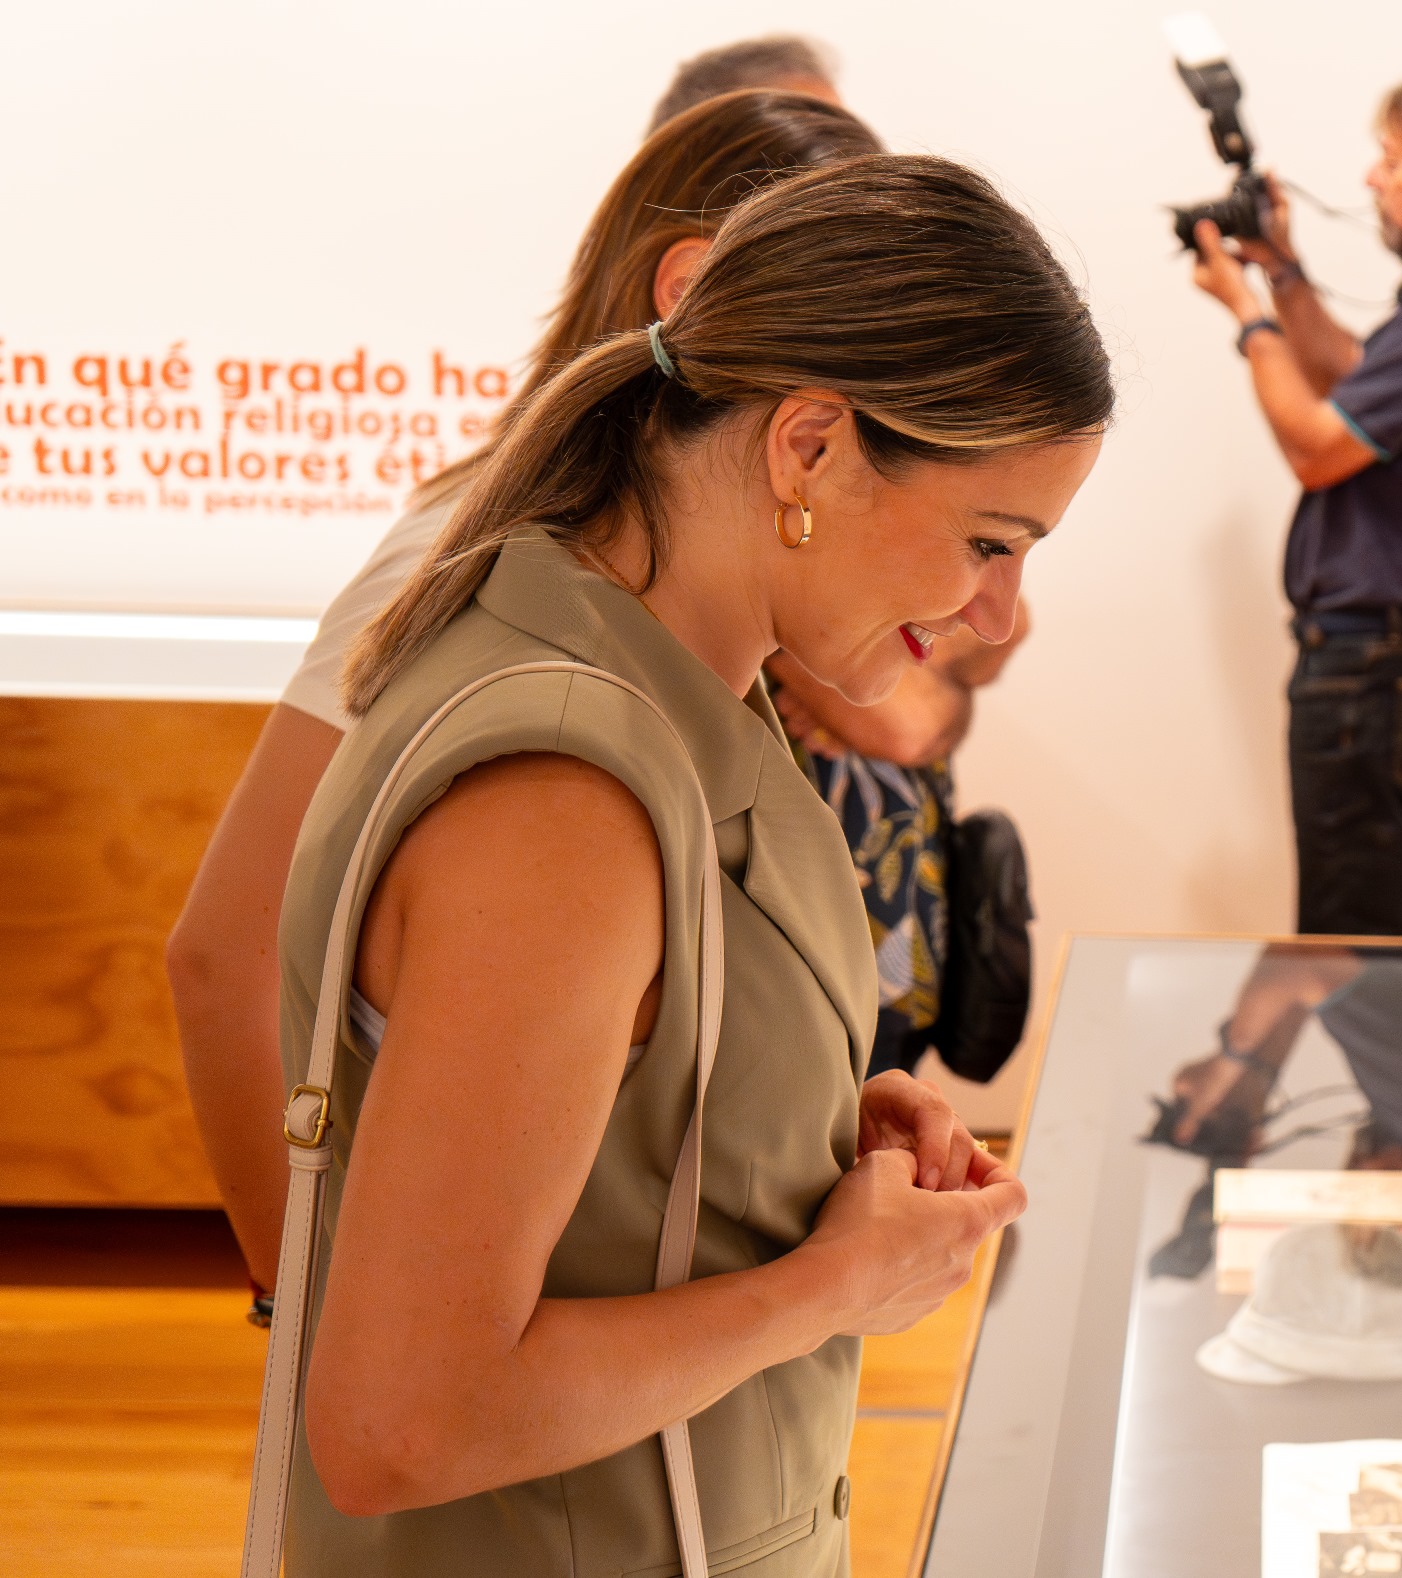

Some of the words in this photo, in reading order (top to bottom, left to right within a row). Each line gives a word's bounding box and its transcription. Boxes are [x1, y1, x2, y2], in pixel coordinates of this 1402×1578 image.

[0, 334, 47, 386] n
[73, 340, 191, 398] qué
[216, 347, 407, 400] grado
[432, 351, 510, 398] ha
[5, 388, 202, 431] ucación
[224, 395, 438, 440] religiosa
[35, 437, 115, 476] tus
[141, 434, 348, 482] valores
